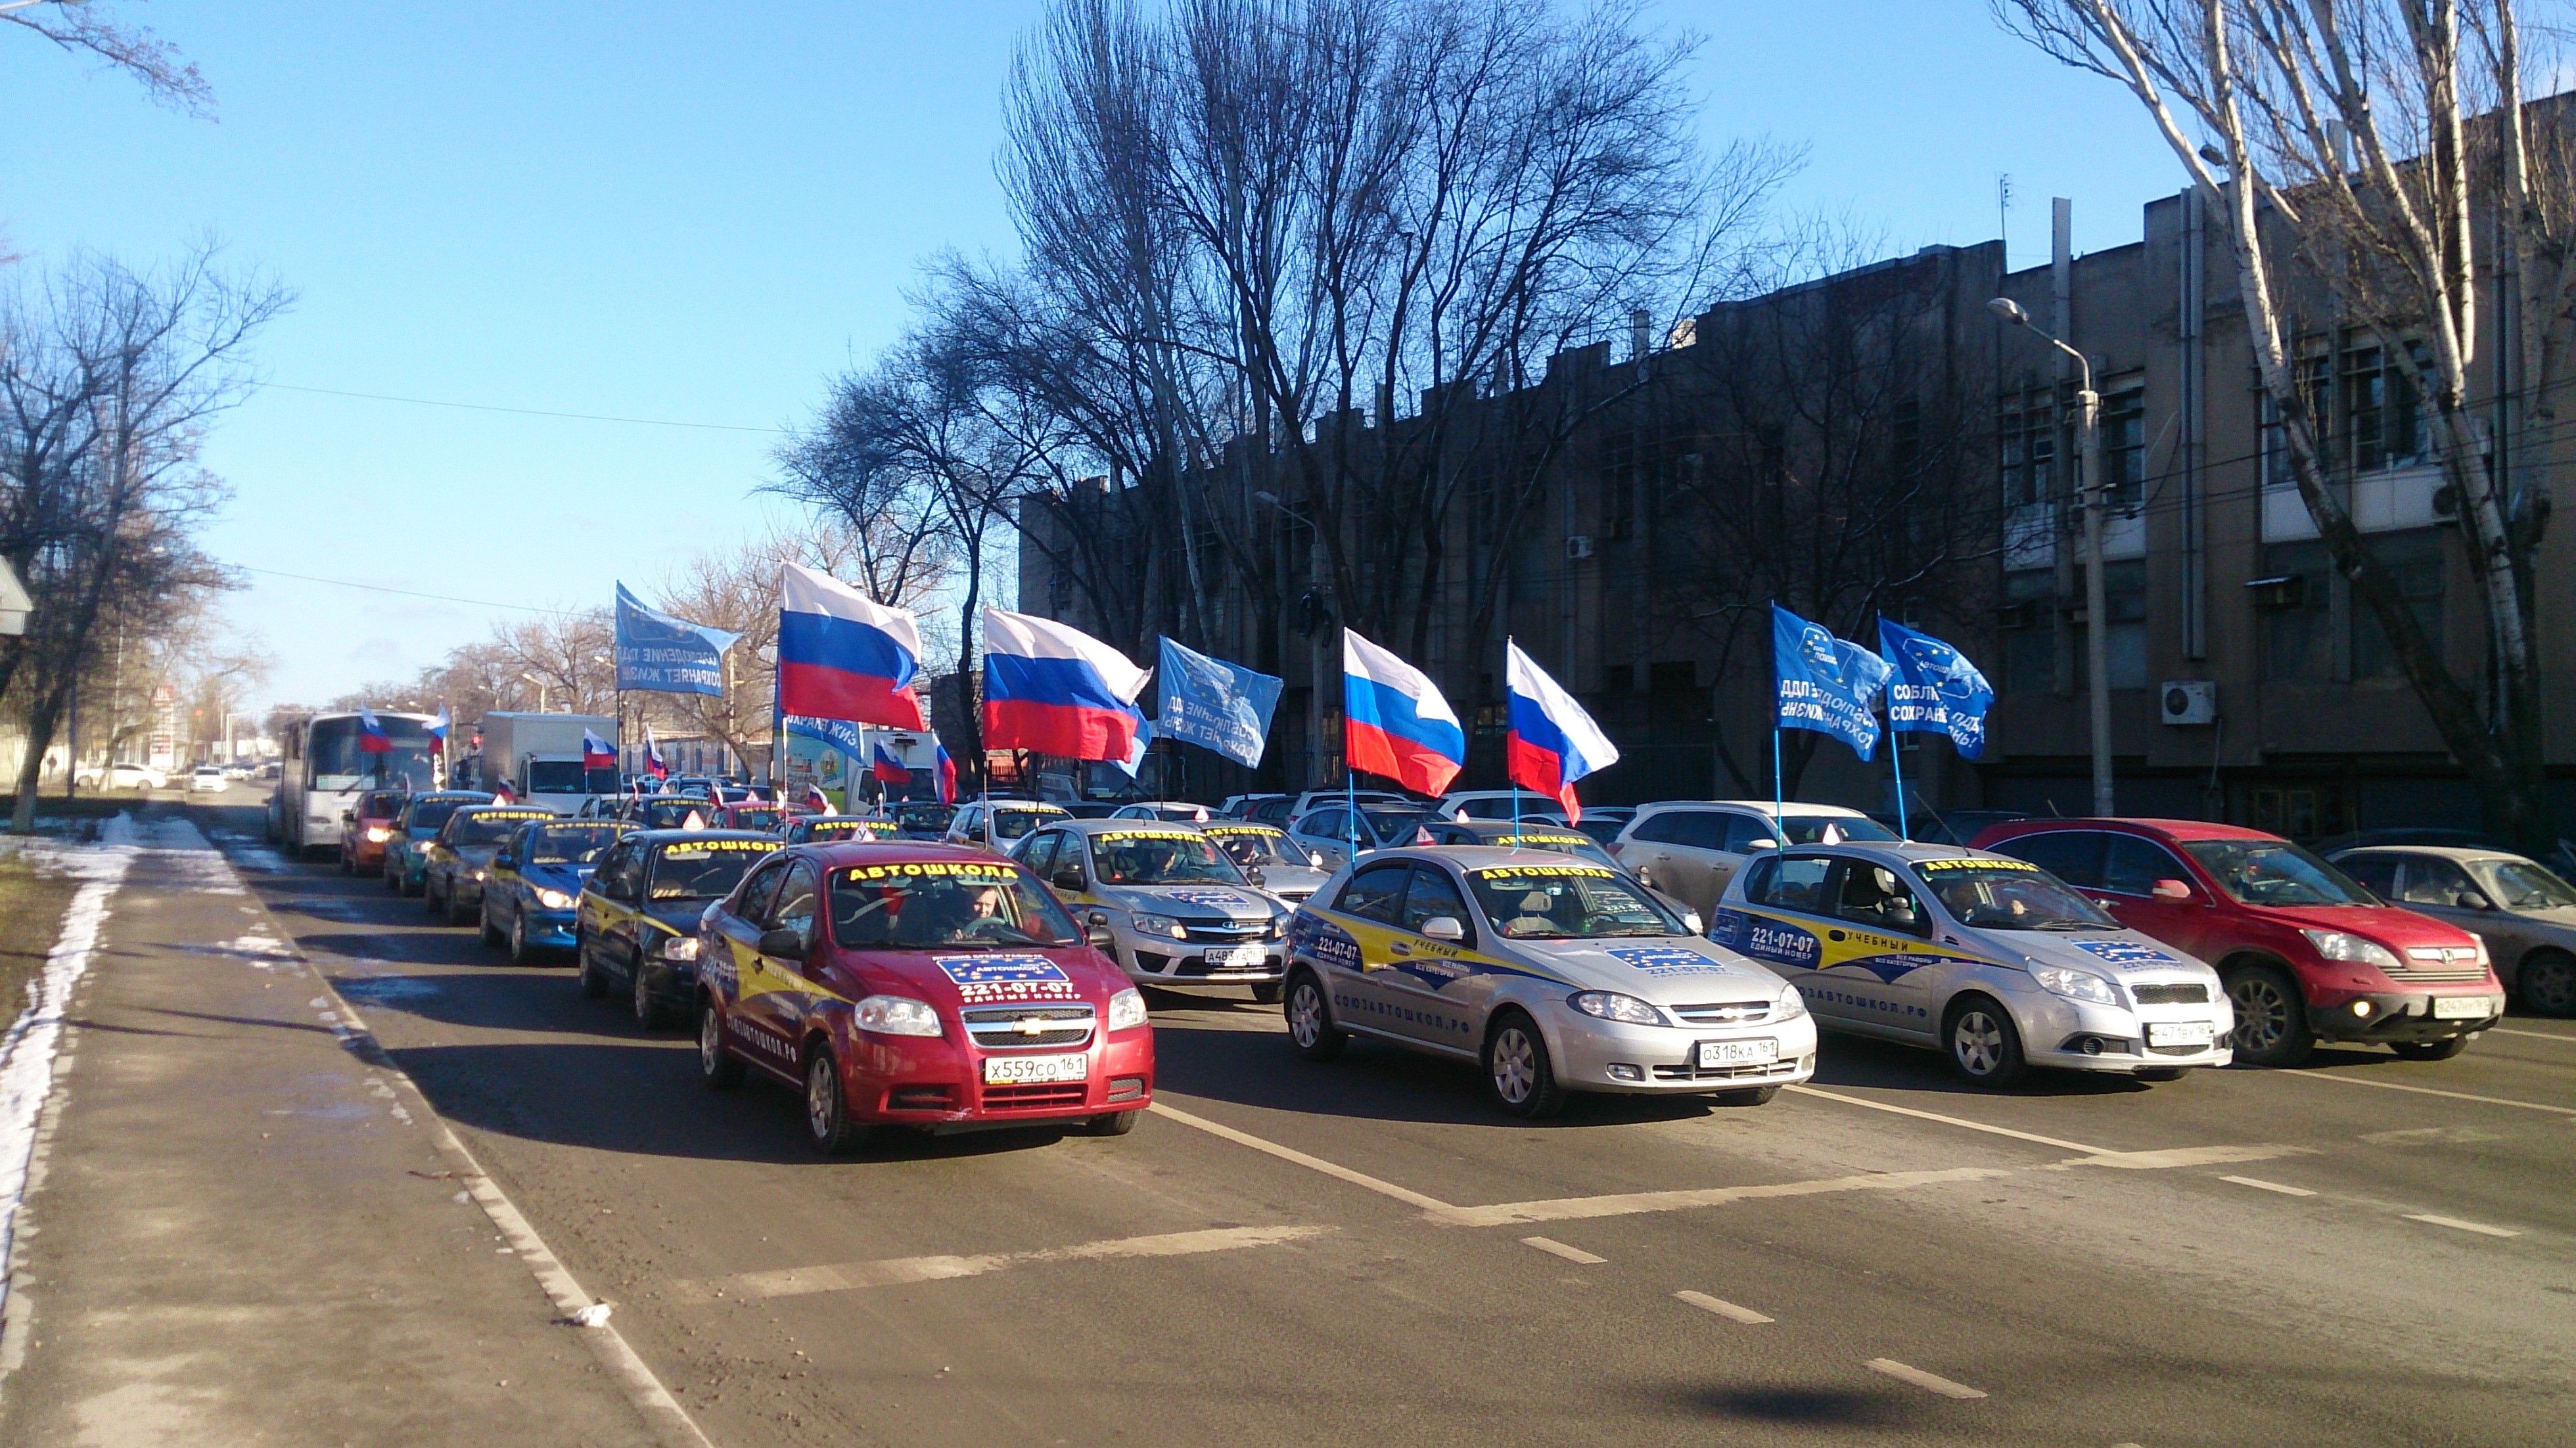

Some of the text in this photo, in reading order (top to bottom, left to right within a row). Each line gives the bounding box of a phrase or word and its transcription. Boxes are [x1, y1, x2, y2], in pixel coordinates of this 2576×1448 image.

[1101, 831, 1206, 844] АВТОШКОЛА
[849, 863, 1019, 882] АВТОШКОЛА
[1481, 867, 1615, 880] АВТОШКОЛА
[1925, 859, 2040, 873] АВТОШКОЛА
[1318, 936, 1357, 960] 221-07-07
[1414, 938, 1459, 959] УЧЕБНЫЙ
[1752, 927, 1814, 953] 221-07-07
[1848, 930, 1908, 952] УЧЕБНЫЙ
[1750, 942, 1812, 961] ЕДИНЫЙ НОМЕР
[959, 982, 1073, 997] 221-07-07
[963, 993, 1028, 1003] ЕДИНЫЙ
[1334, 994, 1470, 1033] СОЮЗАВТОШКОЛ.РФ
[1757, 1041, 1775, 1051] 161
[992, 1057, 1082, 1079] Х559СО 161
